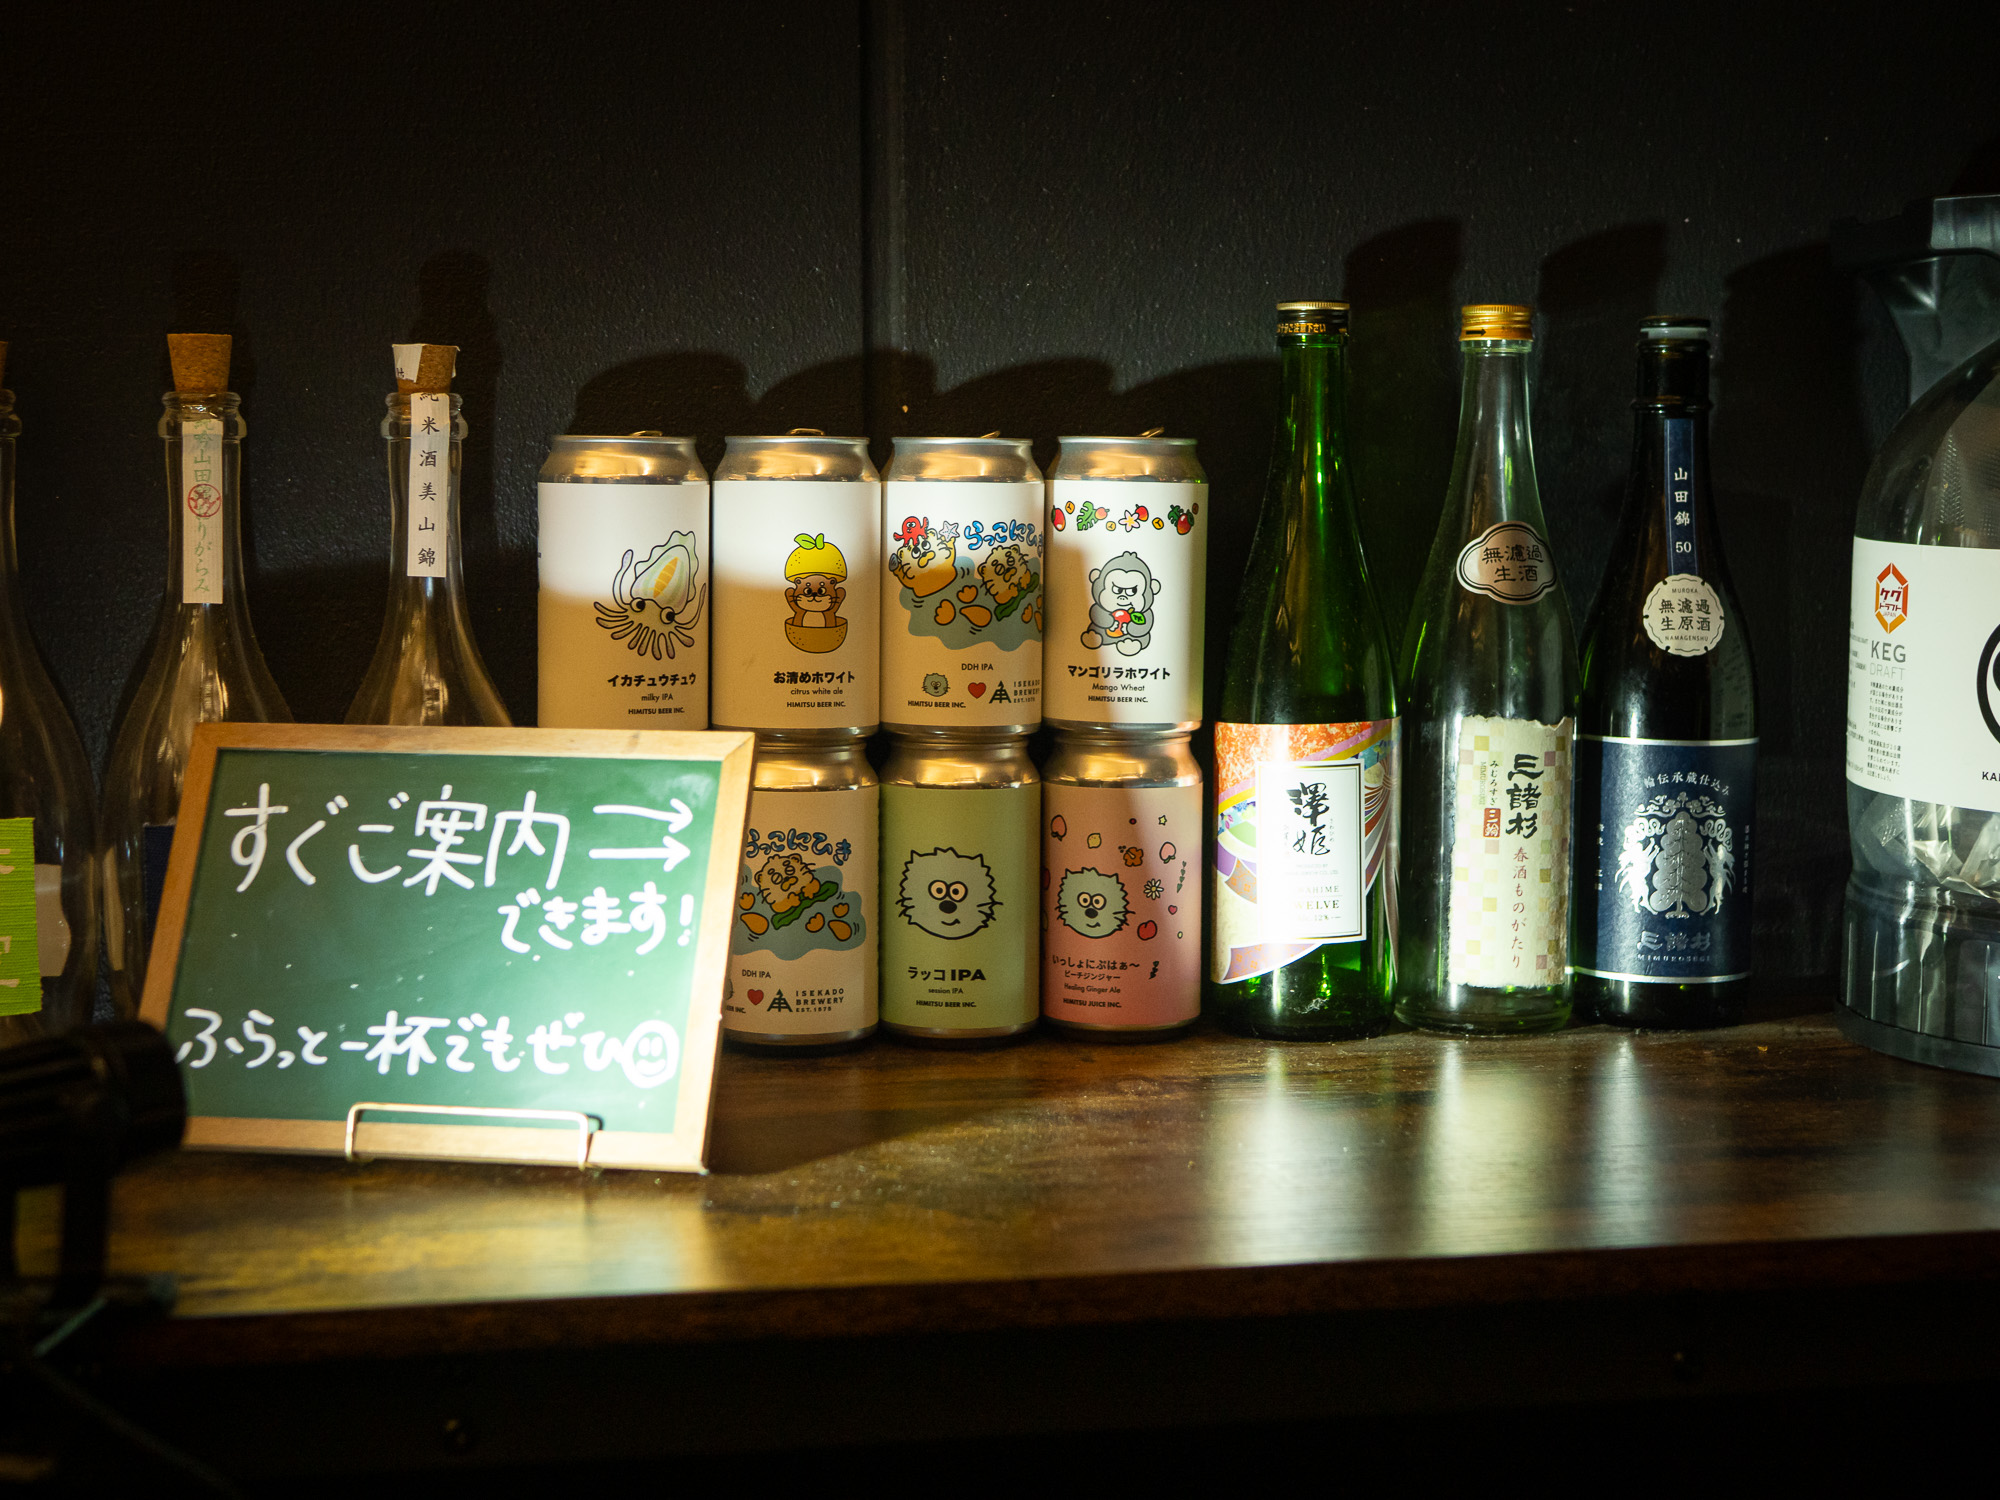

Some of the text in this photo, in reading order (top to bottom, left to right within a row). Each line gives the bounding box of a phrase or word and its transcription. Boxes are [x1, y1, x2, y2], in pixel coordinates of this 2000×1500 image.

[1674, 467, 1692, 553] 山田錦 50
[1482, 544, 1544, 564] 無濾過
[1494, 565, 1538, 583] 生酒
[1880, 587, 1903, 602] ケグ
[1659, 598, 1711, 615] 無濾過
[1661, 616, 1711, 631] 生原酒
[1665, 634, 1709, 642] NAMAGENSHU
[1871, 640, 1906, 663] KEG
[773, 671, 855, 684] お清めホワイト
[1067, 665, 1171, 680] マンゴリラホワイト
[1870, 662, 1906, 680] DRAFT
[607, 672, 697, 687] イカチュウチュウ
[812, 687, 831, 695] white
[1092, 683, 1118, 692] Mango
[641, 693, 673, 703] milky IPA
[907, 700, 933, 708] HIMITSU
[1982, 771, 2000, 781] KA
[1505, 753, 1544, 839] 三諸杉
[224, 782, 571, 896] すぐご案内
[746, 828, 853, 866] らっこにひき
[1293, 899, 1340, 911] WELVE
[1511, 846, 1529, 968] 春酒ものがたり
[498, 882, 695, 955] できます!
[1637, 930, 1711, 951] 三諸杉
[1637, 953, 1711, 962] MIMUROSUGI
[741, 969, 772, 979] DDH IPA
[908, 966, 987, 981] ラッコ IPA
[1064, 970, 1121, 981] ピーチジンジャー
[796, 988, 844, 998] ISEKADO
[1064, 982, 1085, 993] Healing
[1086, 986, 1108, 994] Ginger
[796, 996, 844, 1006] BREWERY
[1063, 998, 1087, 1006] HIMITSU
[735, 1006, 747, 1014] INC.
[175, 1008, 625, 1075] ふらっと一杯でもぜひ
